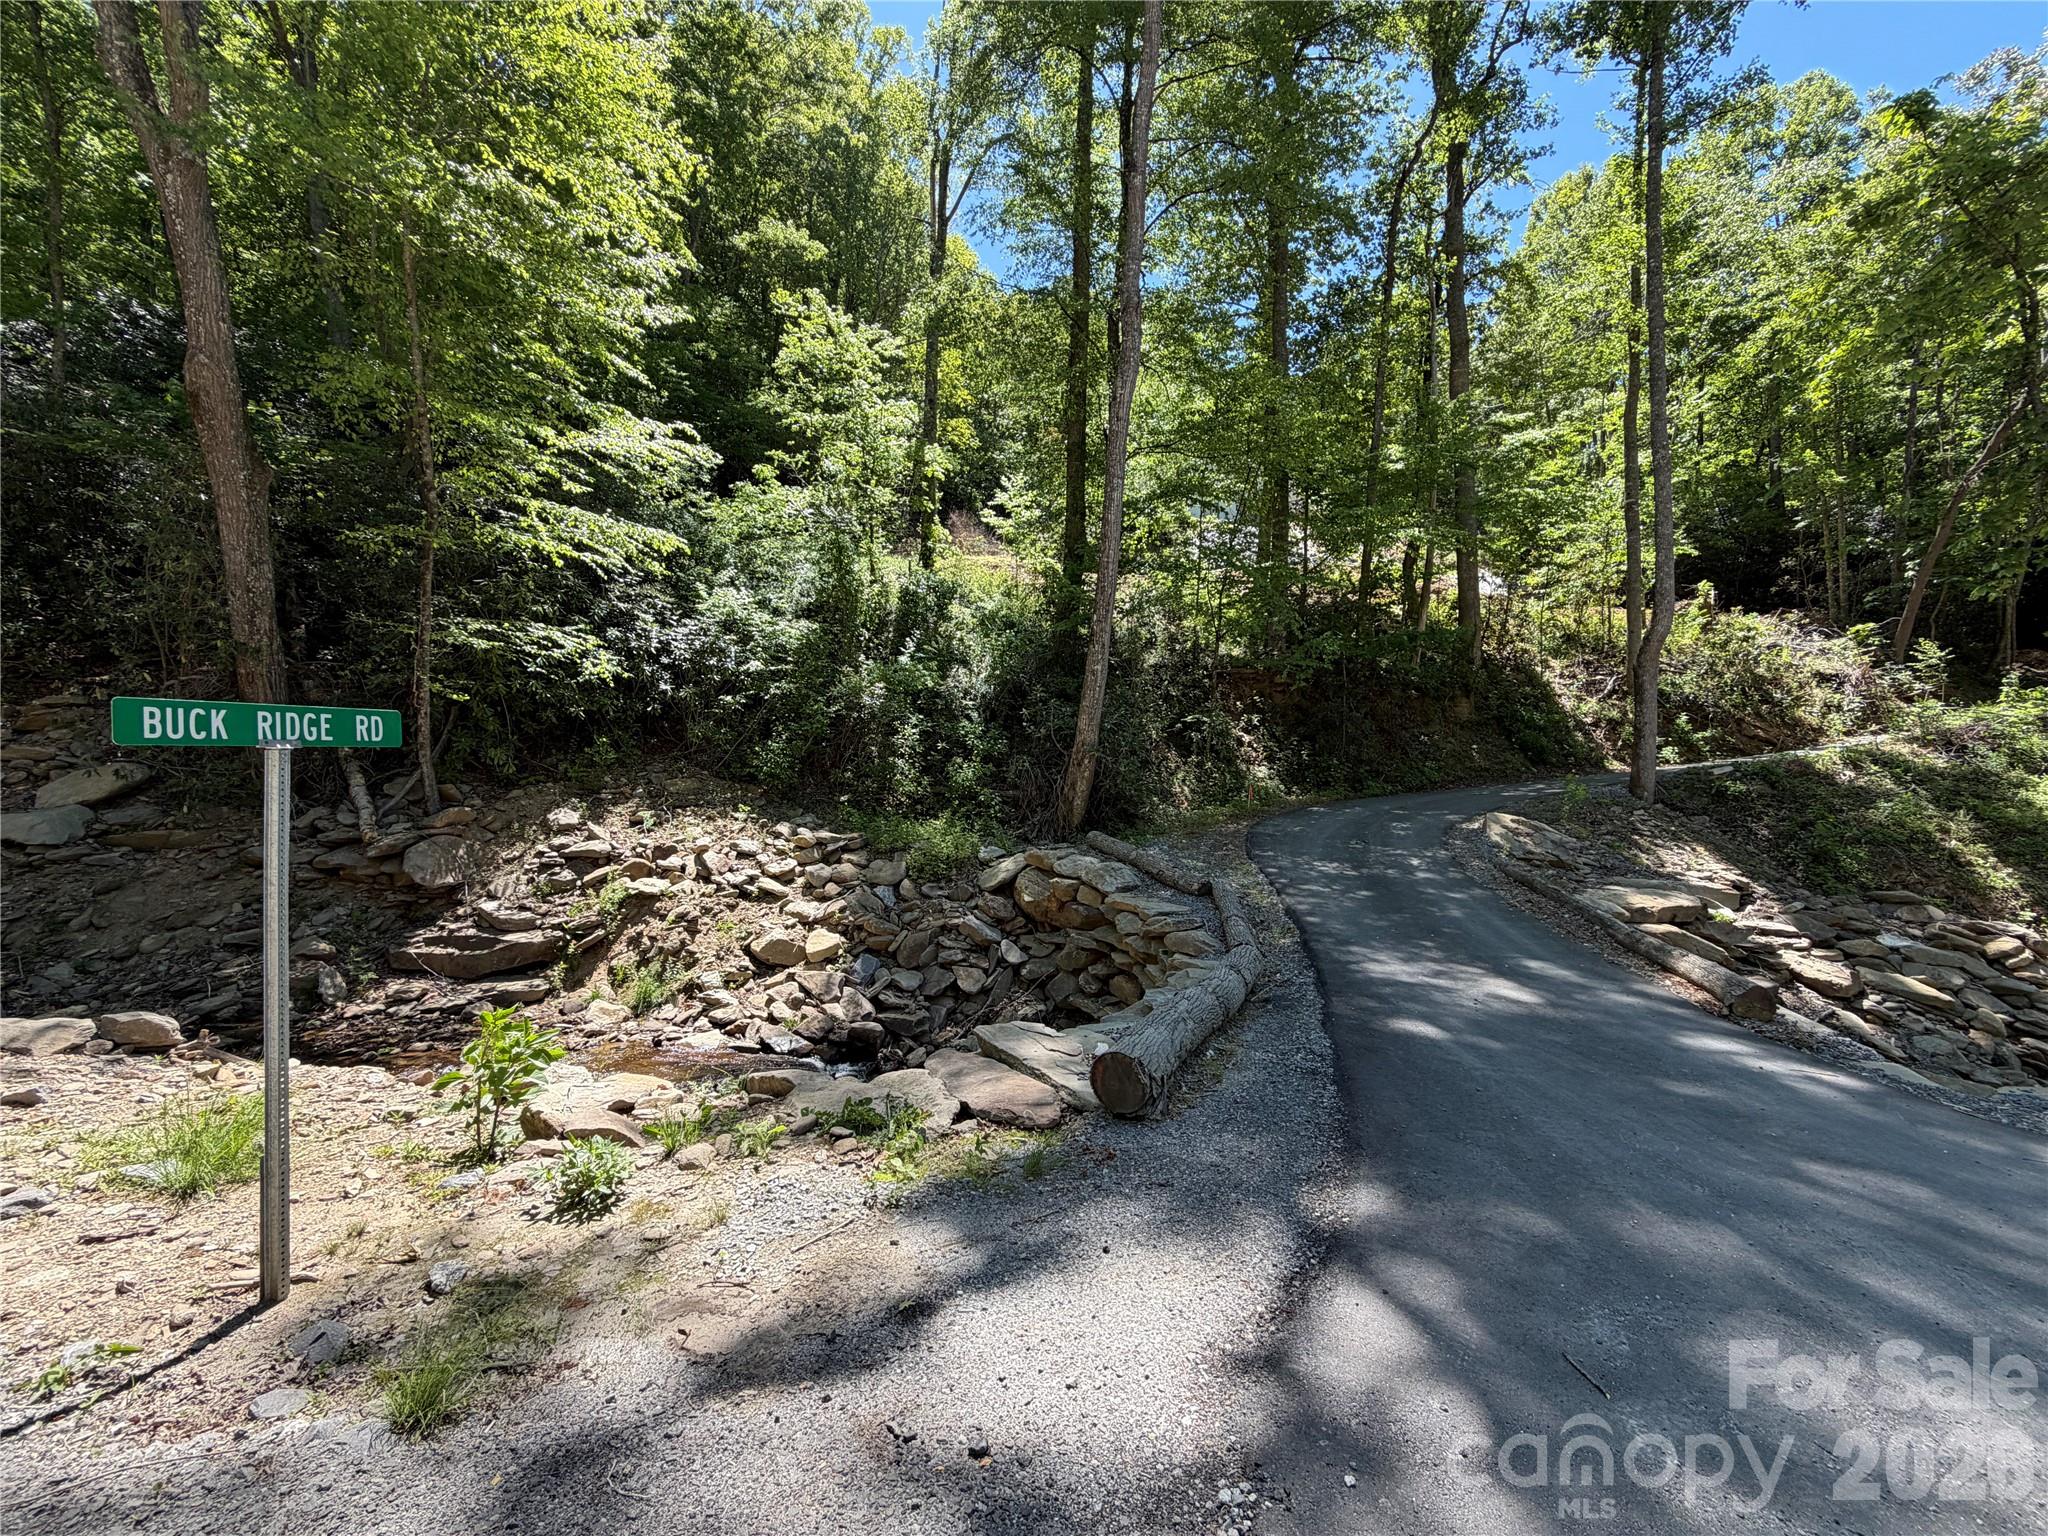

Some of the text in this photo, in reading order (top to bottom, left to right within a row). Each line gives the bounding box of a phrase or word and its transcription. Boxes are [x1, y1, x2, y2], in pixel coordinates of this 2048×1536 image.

[143, 706, 384, 742] BUCK RIDGE RD
